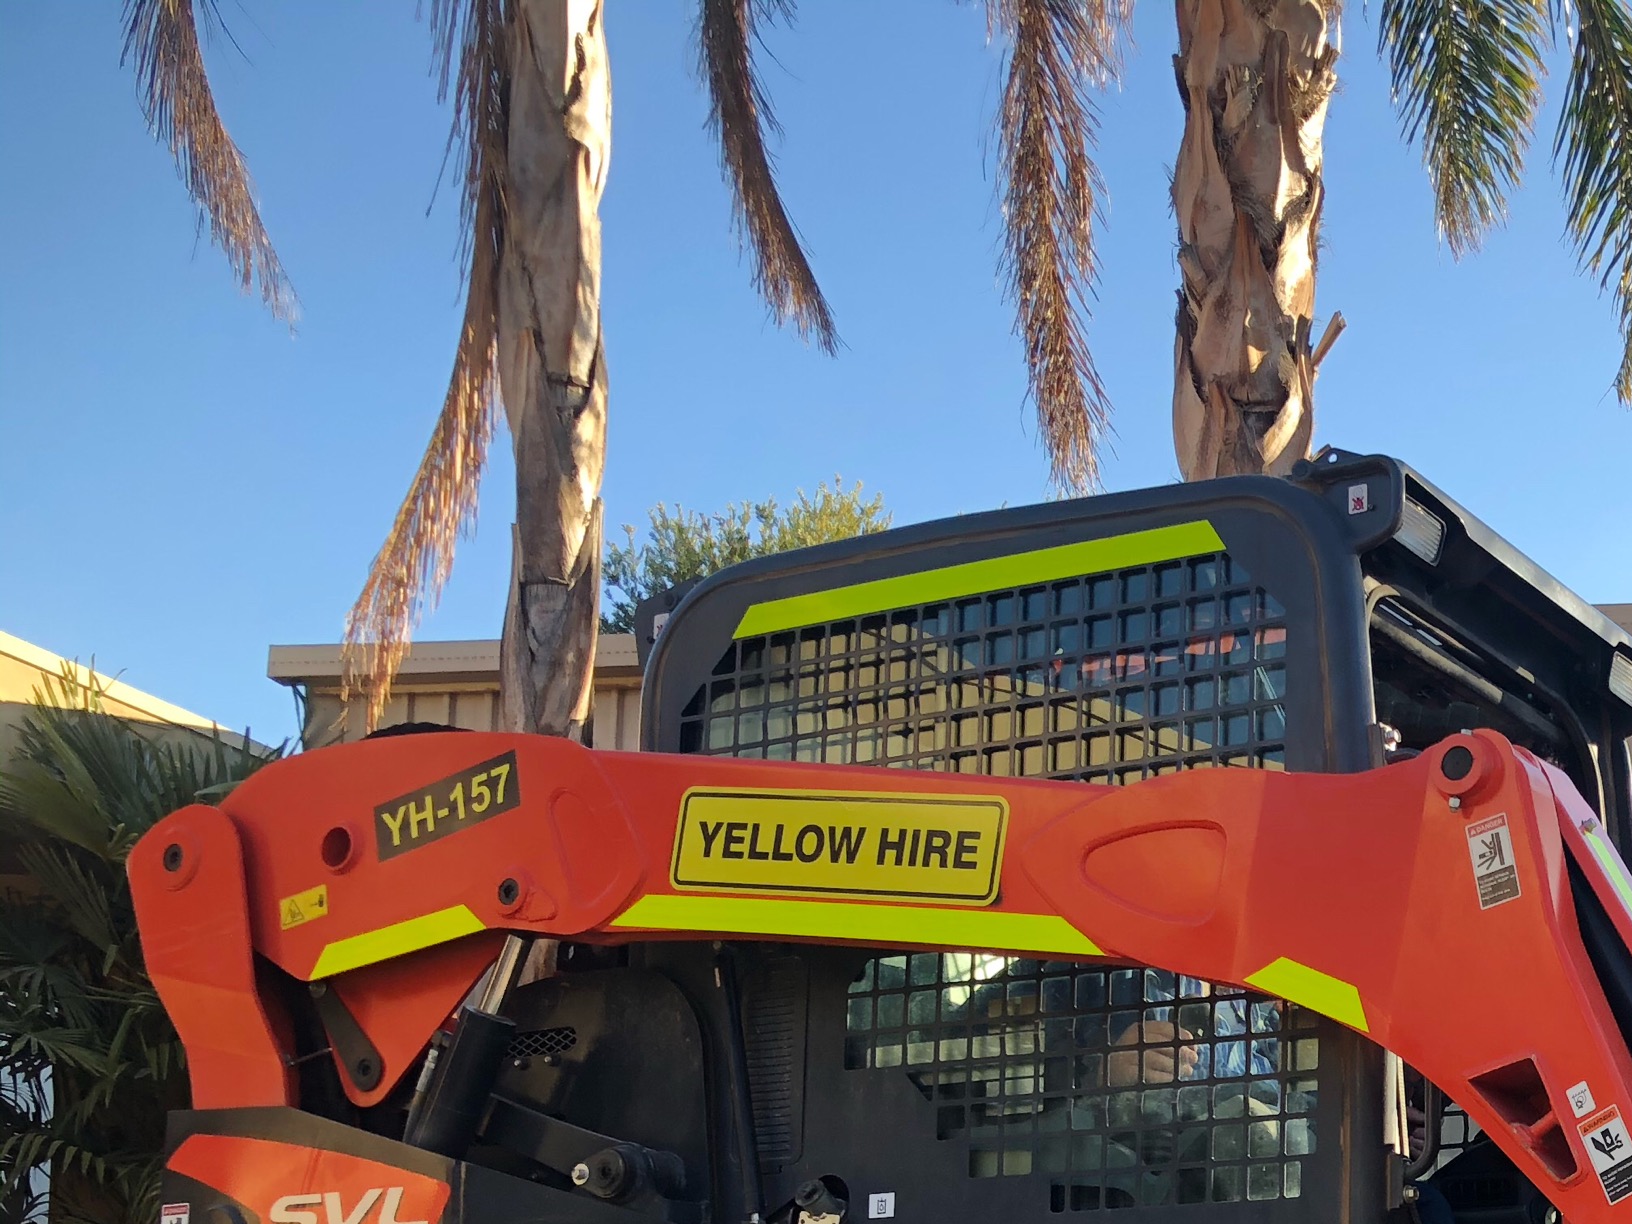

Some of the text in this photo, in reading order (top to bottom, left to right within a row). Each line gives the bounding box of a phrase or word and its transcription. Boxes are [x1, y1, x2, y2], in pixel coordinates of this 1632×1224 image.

[381, 763, 510, 847] YH-157
[1476, 818, 1503, 832] DANGER
[699, 821, 981, 870] YELLOW HIRE
[1588, 1110, 1616, 1130] WARNING
